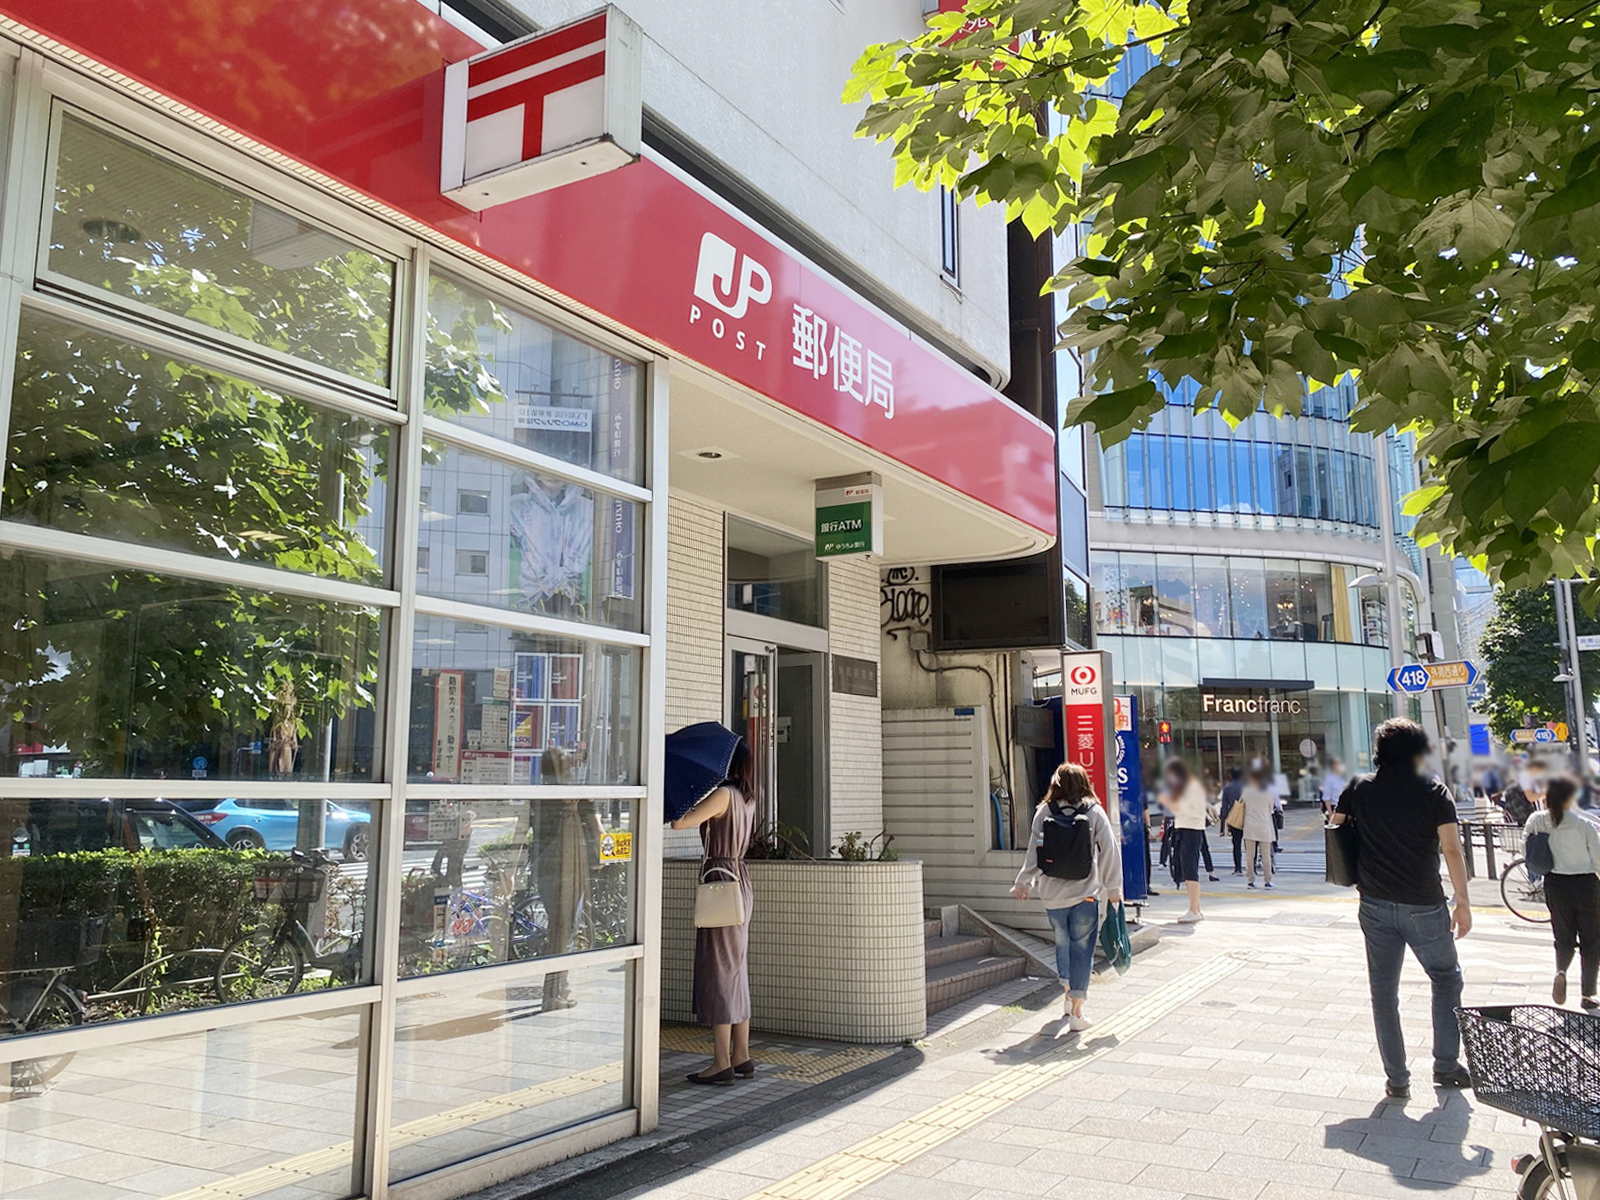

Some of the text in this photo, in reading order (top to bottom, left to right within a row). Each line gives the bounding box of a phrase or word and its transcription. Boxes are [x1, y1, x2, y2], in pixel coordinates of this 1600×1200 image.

[689, 304, 766, 361] POST
[792, 303, 894, 420] 郵便局
[820, 519, 862, 533] 銀行ATM
[1401, 670, 1426, 686] 418
[1071, 686, 1097, 695] MUFG
[1202, 694, 1301, 714] Francfranc
